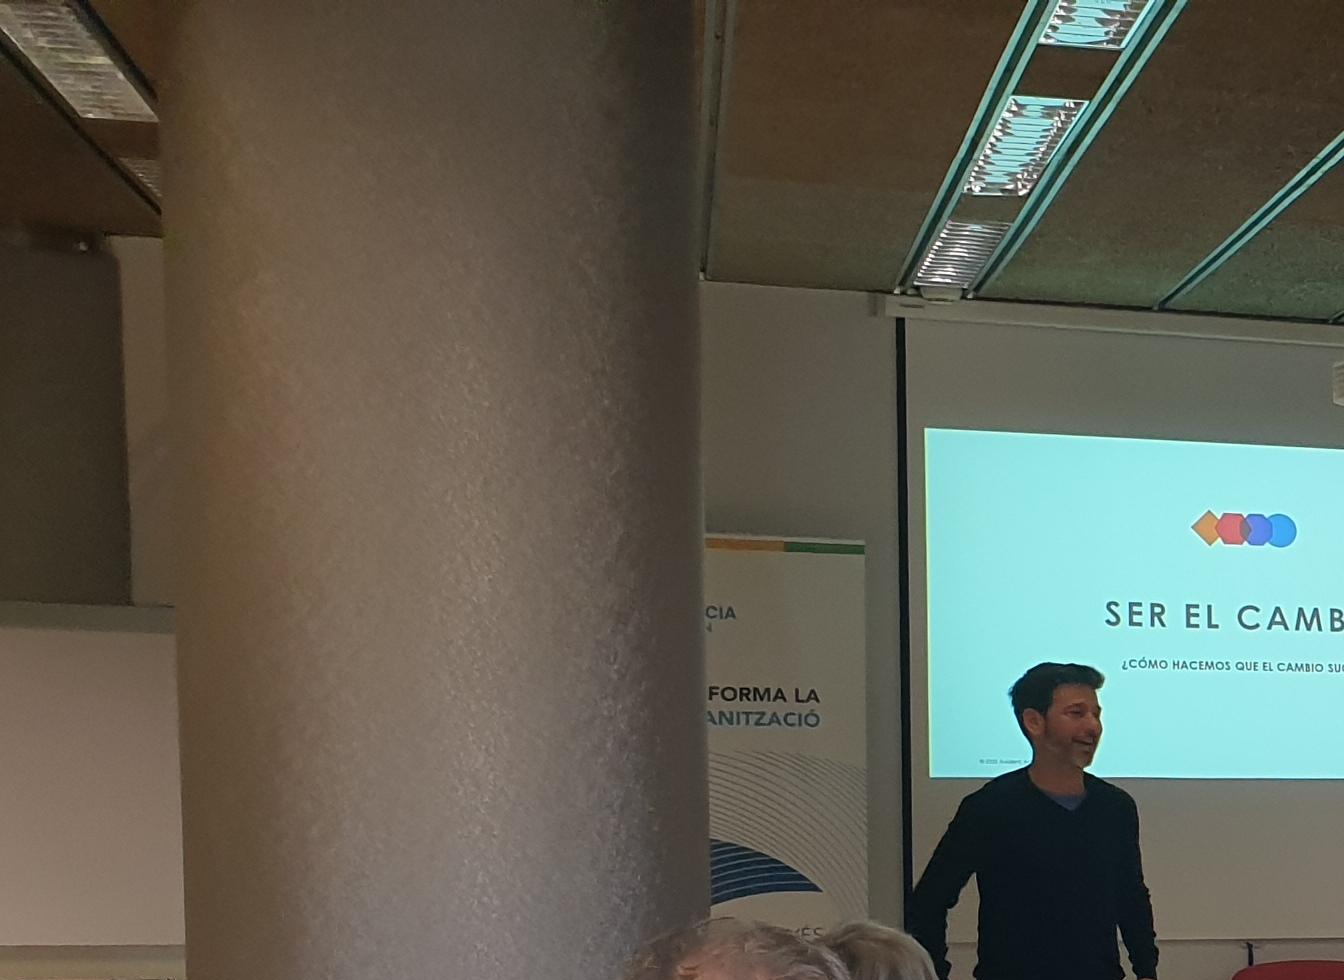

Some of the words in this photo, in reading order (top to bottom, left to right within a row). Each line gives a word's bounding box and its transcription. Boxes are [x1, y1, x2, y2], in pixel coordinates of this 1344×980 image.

[1104, 600, 1167, 628] SER
[1185, 603, 1220, 629] EL
[1121, 656, 1169, 671] ¿CÓMO
[1172, 660, 1232, 671] HACEMOS
[1235, 661, 1259, 672] QUE
[1262, 661, 1274, 672] EL
[1276, 662, 1324, 673] CAMBIO
[708, 685, 788, 703] FORMA
[794, 687, 820, 704] LA
